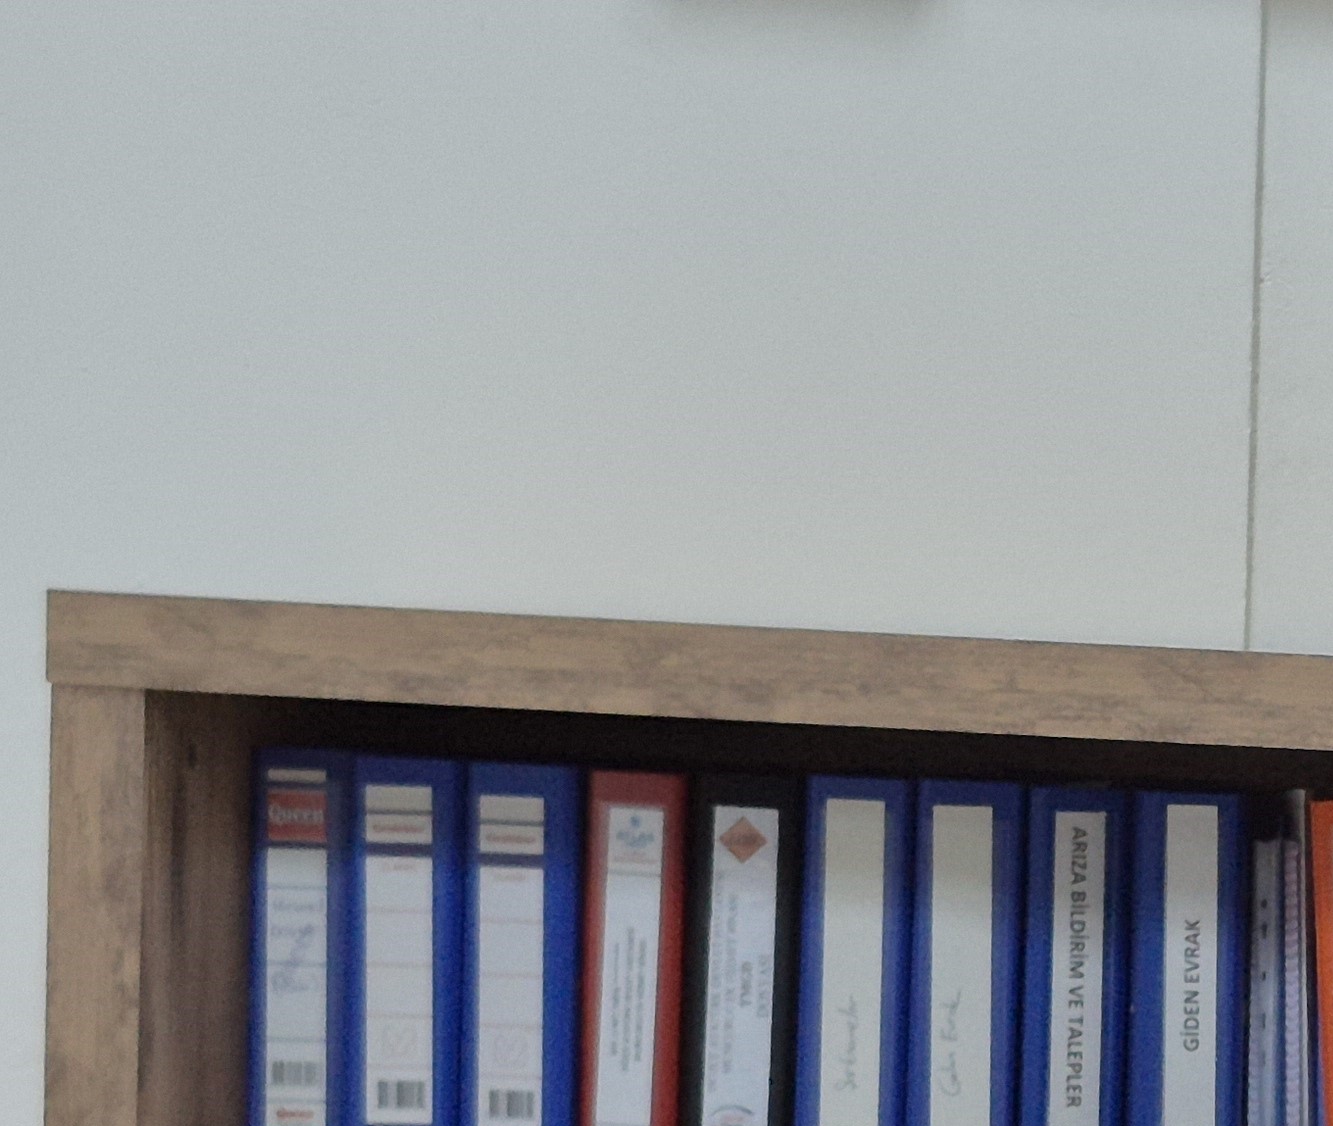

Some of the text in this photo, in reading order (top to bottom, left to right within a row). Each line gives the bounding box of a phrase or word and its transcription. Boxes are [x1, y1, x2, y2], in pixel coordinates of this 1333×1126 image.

[1065, 826, 1090, 1109] ARIZA BİLDİRİM VE TALEPLER
[1182, 918, 1201, 1052] GİDEN EVRAK
